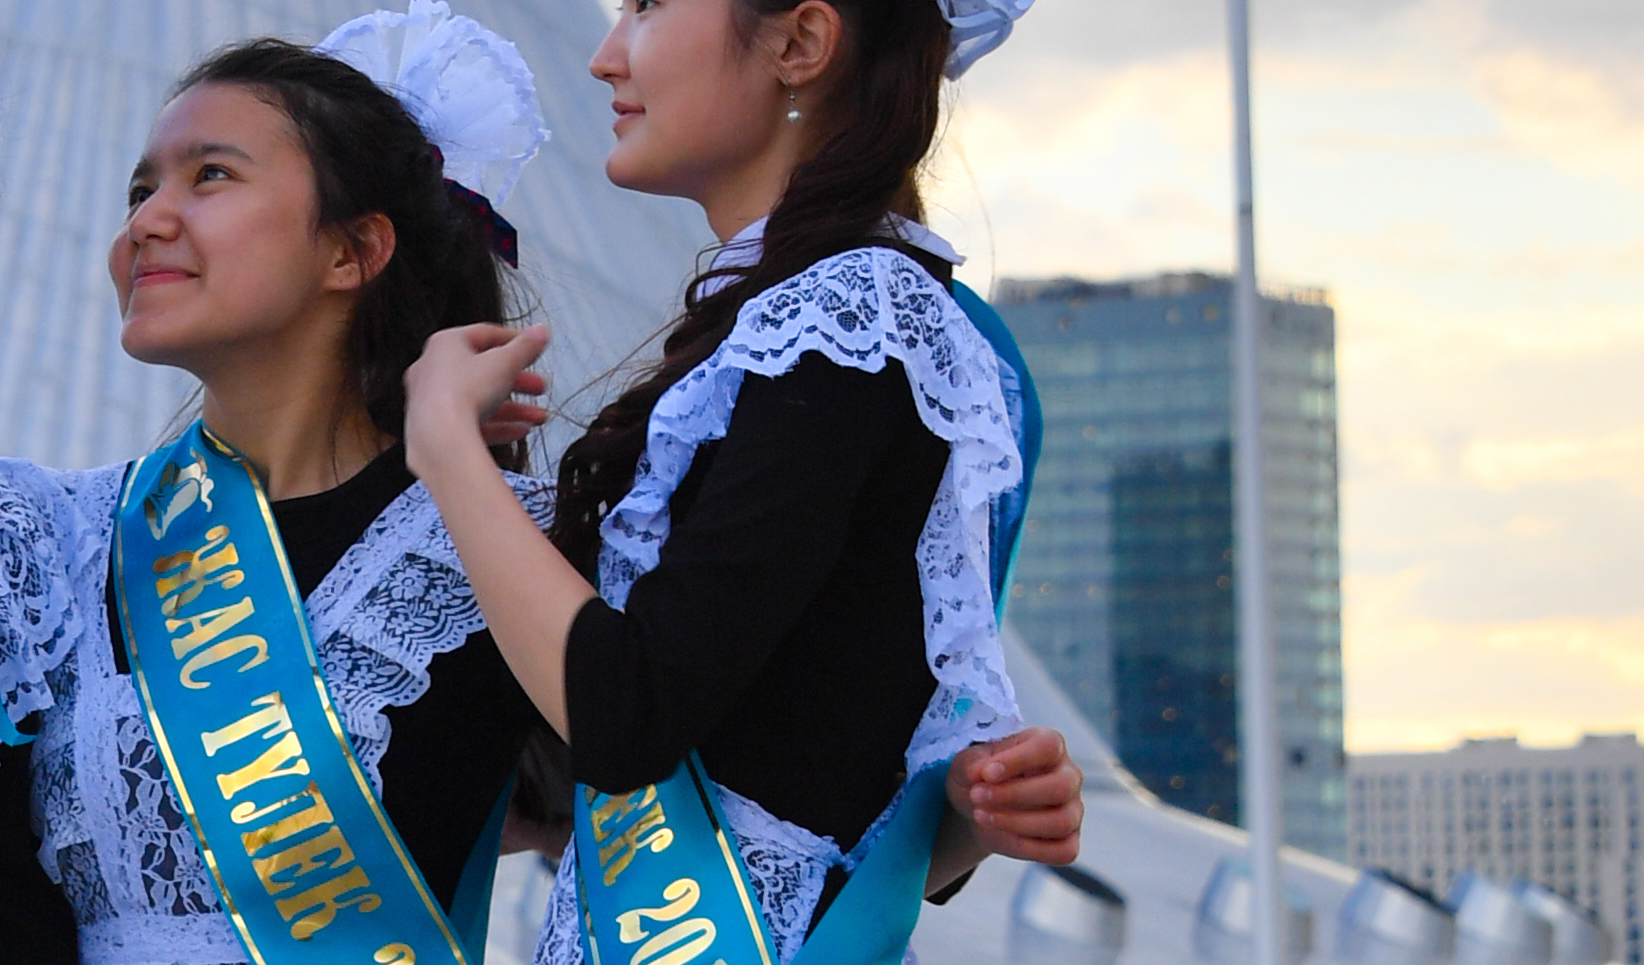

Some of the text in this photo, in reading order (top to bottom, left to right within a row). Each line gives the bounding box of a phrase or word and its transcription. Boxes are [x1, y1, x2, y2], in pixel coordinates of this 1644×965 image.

[152, 525, 270, 689] ЖАС
[585, 784, 729, 965] ЕК 20
